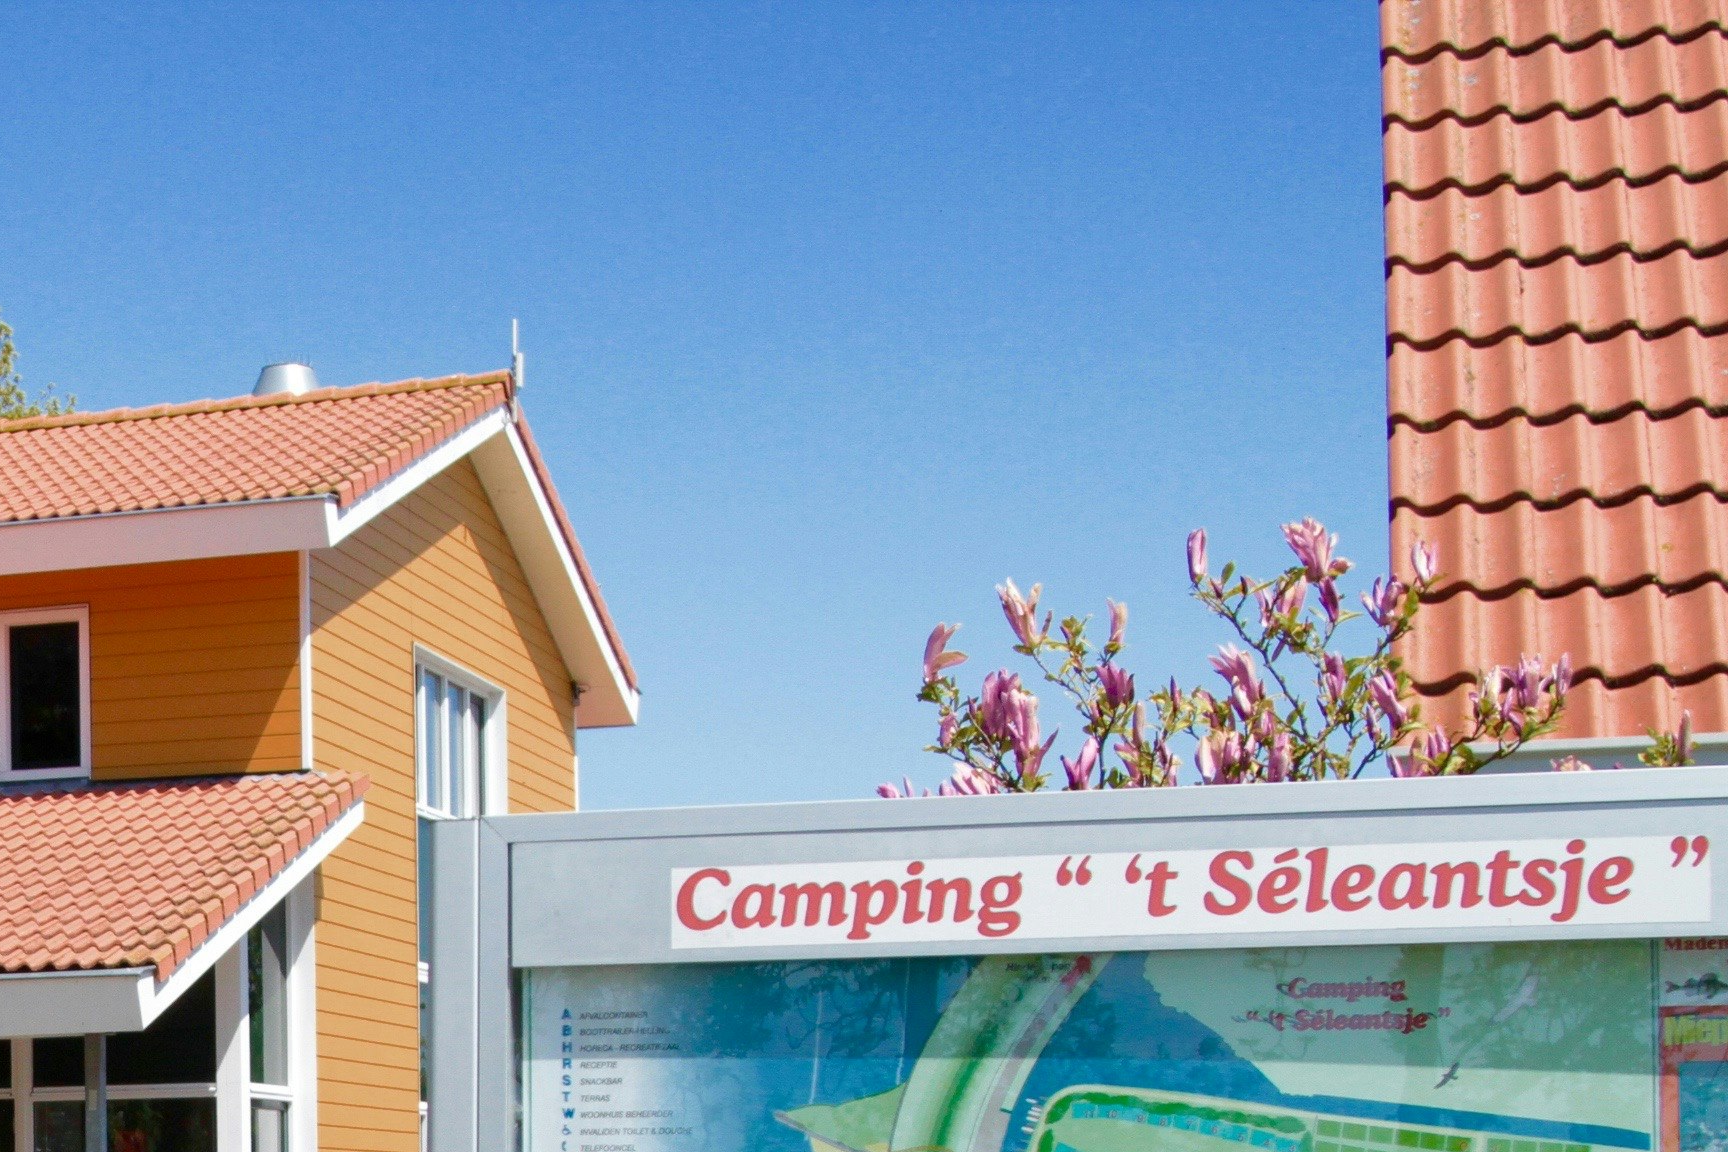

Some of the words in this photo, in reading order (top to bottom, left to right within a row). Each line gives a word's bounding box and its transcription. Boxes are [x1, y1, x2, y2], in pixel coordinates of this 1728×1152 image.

[676, 861, 1023, 940] Camping
[1204, 839, 1635, 922] Séleantsje
[1284, 977, 1408, 1002] Camping
[561, 1008, 571, 1020] A
[1293, 1008, 1429, 1034] Séleantsje
[562, 1042, 572, 1053] H
[562, 1058, 572, 1069] R
[562, 1075, 572, 1086] S
[580, 1078, 622, 1086] SNACKBAR
[562, 1091, 570, 1102] T
[580, 1094, 610, 1102] TERRAS
[562, 1108, 575, 1119] W
